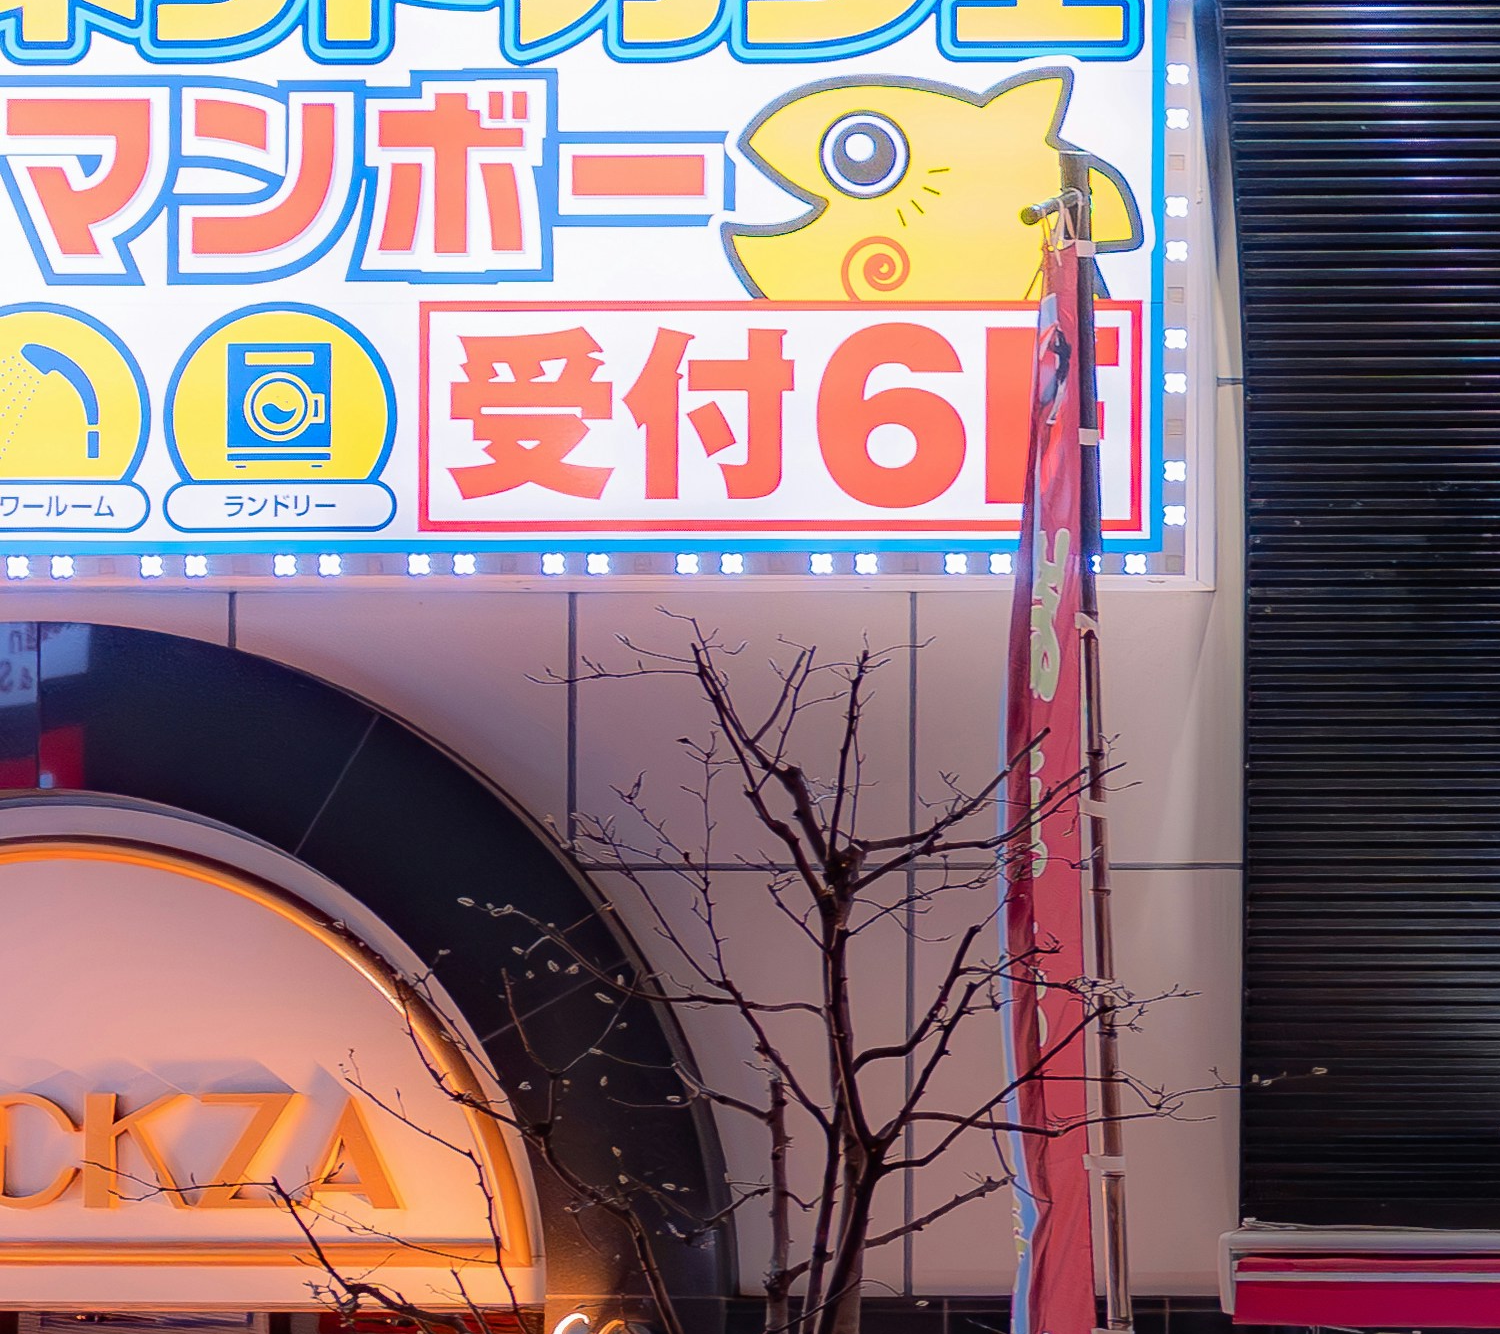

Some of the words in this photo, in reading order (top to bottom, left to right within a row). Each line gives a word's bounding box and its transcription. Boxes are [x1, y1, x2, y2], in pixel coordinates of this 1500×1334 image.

[4, 79, 726, 263] マンボー
[0, 495, 115, 517] ワールーム
[223, 495, 336, 517] ランドリー
